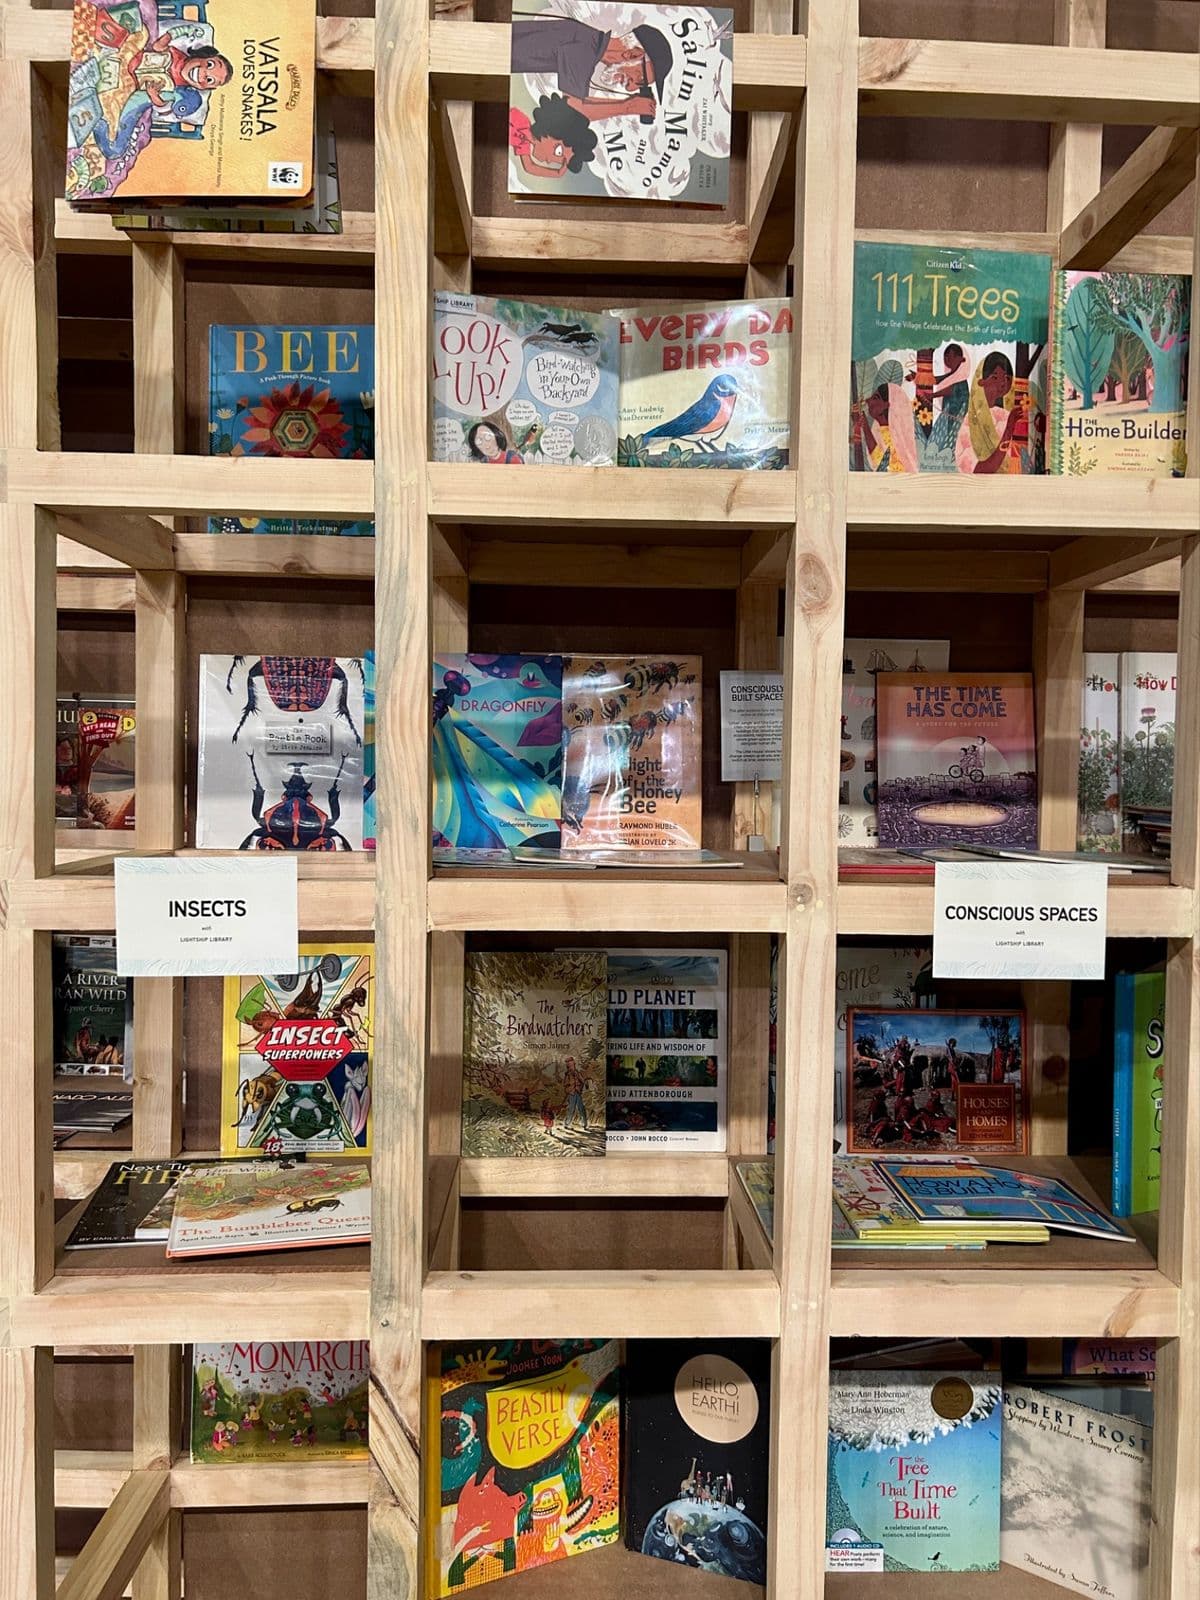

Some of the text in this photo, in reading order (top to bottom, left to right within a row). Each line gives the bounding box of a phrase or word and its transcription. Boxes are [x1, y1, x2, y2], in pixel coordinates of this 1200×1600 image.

[672, 17, 707, 101] Salim
[239, 39, 256, 141] LOVES SNAKES!
[256, 36, 280, 136] VATSALA
[603, 130, 628, 172] Me
[635, 139, 647, 165] and
[642, 110, 688, 188] Mamoo
[450, 299, 475, 309] LIBRARY
[872, 272, 1020, 324] 111 Trees
[902, 320, 922, 331] Village
[923, 321, 952, 332] Celebrates
[955, 323, 965, 332] the
[982, 325, 990, 333] of
[228, 330, 360, 373] BEE
[455, 361, 507, 411] UP!
[538, 384, 589, 404] Backyard
[639, 405, 665, 414] Ludwig
[1065, 417, 1121, 438] Home
[1084, 418, 1098, 426] THE
[732, 693, 752, 702] BUILT
[913, 686, 1003, 702] THE TIME
[461, 699, 547, 713] DRAGONFLY
[906, 702, 1007, 718] HAS COME
[101, 732, 114, 740] OUT
[622, 757, 662, 776] light
[646, 774, 665, 787] the
[633, 780, 683, 804] Honey
[526, 821, 549, 829] Pearson
[168, 899, 247, 917] INSECTS
[945, 905, 1098, 922] CONSCIOUS SPACES
[63, 973, 73, 985] A
[88, 988, 127, 1001] WILD
[634, 989, 696, 1005] PLANET
[537, 1000, 554, 1015] The
[506, 1014, 594, 1037] Birdwatchers
[267, 1025, 349, 1046] INSECT
[523, 1041, 570, 1050] Simon James
[263, 1049, 344, 1060] SUPERPOWERS
[629, 1090, 693, 1098] ATTENBOROUGH
[964, 1097, 1009, 1109] HOUSES
[966, 1115, 1008, 1127] HOMES
[265, 1141, 280, 1152] 18
[119, 1164, 162, 1172] Next
[969, 1179, 981, 1187] A
[220, 1220, 311, 1233] Bumblebee
[318, 1215, 370, 1225] Queen
[1089, 1346, 1134, 1362] What
[506, 1353, 563, 1376] JOOHEE YOON
[692, 1375, 739, 1398] HELLO,
[838, 1391, 854, 1399] Mary
[873, 1390, 910, 1399] Hoberman
[497, 1384, 567, 1425] BEASTLY
[692, 1393, 740, 1416] EARTH!
[851, 1406, 905, 1415] Linda Winston
[1002, 1392, 1149, 1451] ROBERT FROST
[502, 1418, 563, 1455] VERSE
[1008, 1408, 1037, 1427] Stopping
[1038, 1419, 1047, 1431] by
[1113, 1444, 1145, 1463] Evening
[889, 1456, 929, 1481] Tree
[877, 1478, 957, 1499] That Time
[894, 1500, 941, 1520] Built
